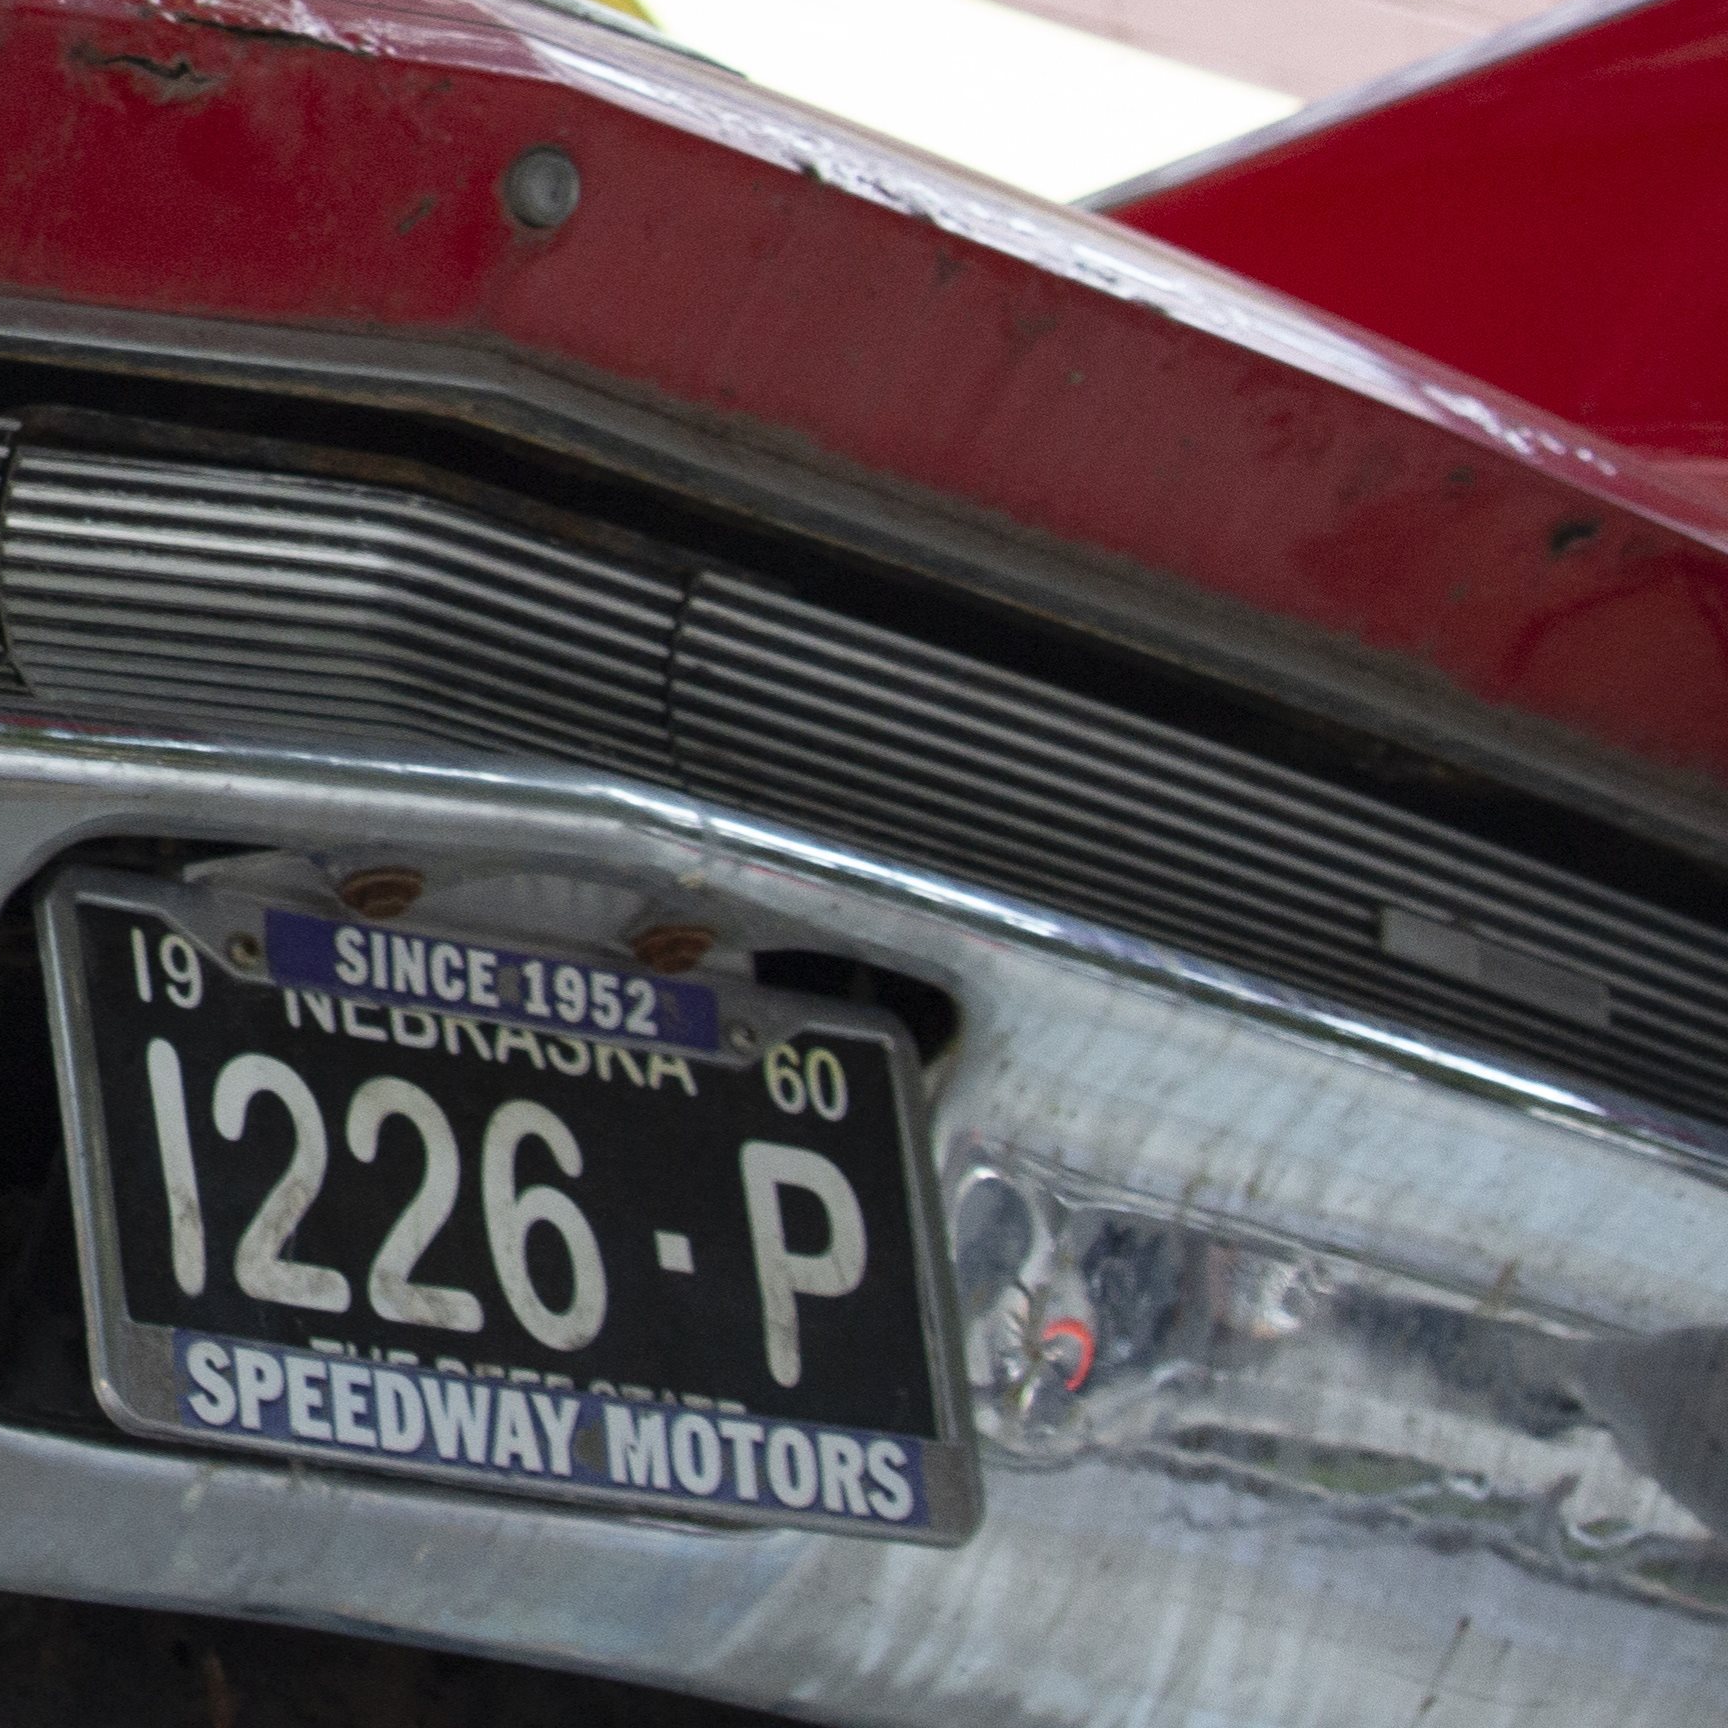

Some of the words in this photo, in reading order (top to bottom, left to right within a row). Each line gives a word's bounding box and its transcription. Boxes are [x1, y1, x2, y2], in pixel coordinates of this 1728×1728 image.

[131, 927, 204, 1009] 19
[763, 1045, 850, 1123] 60
[334, 925, 499, 1009] SINCE
[521, 959, 659, 1037] 1952
[185, 1339, 582, 1479] SPEEDWAY
[605, 1409, 916, 1523] MOTORS
